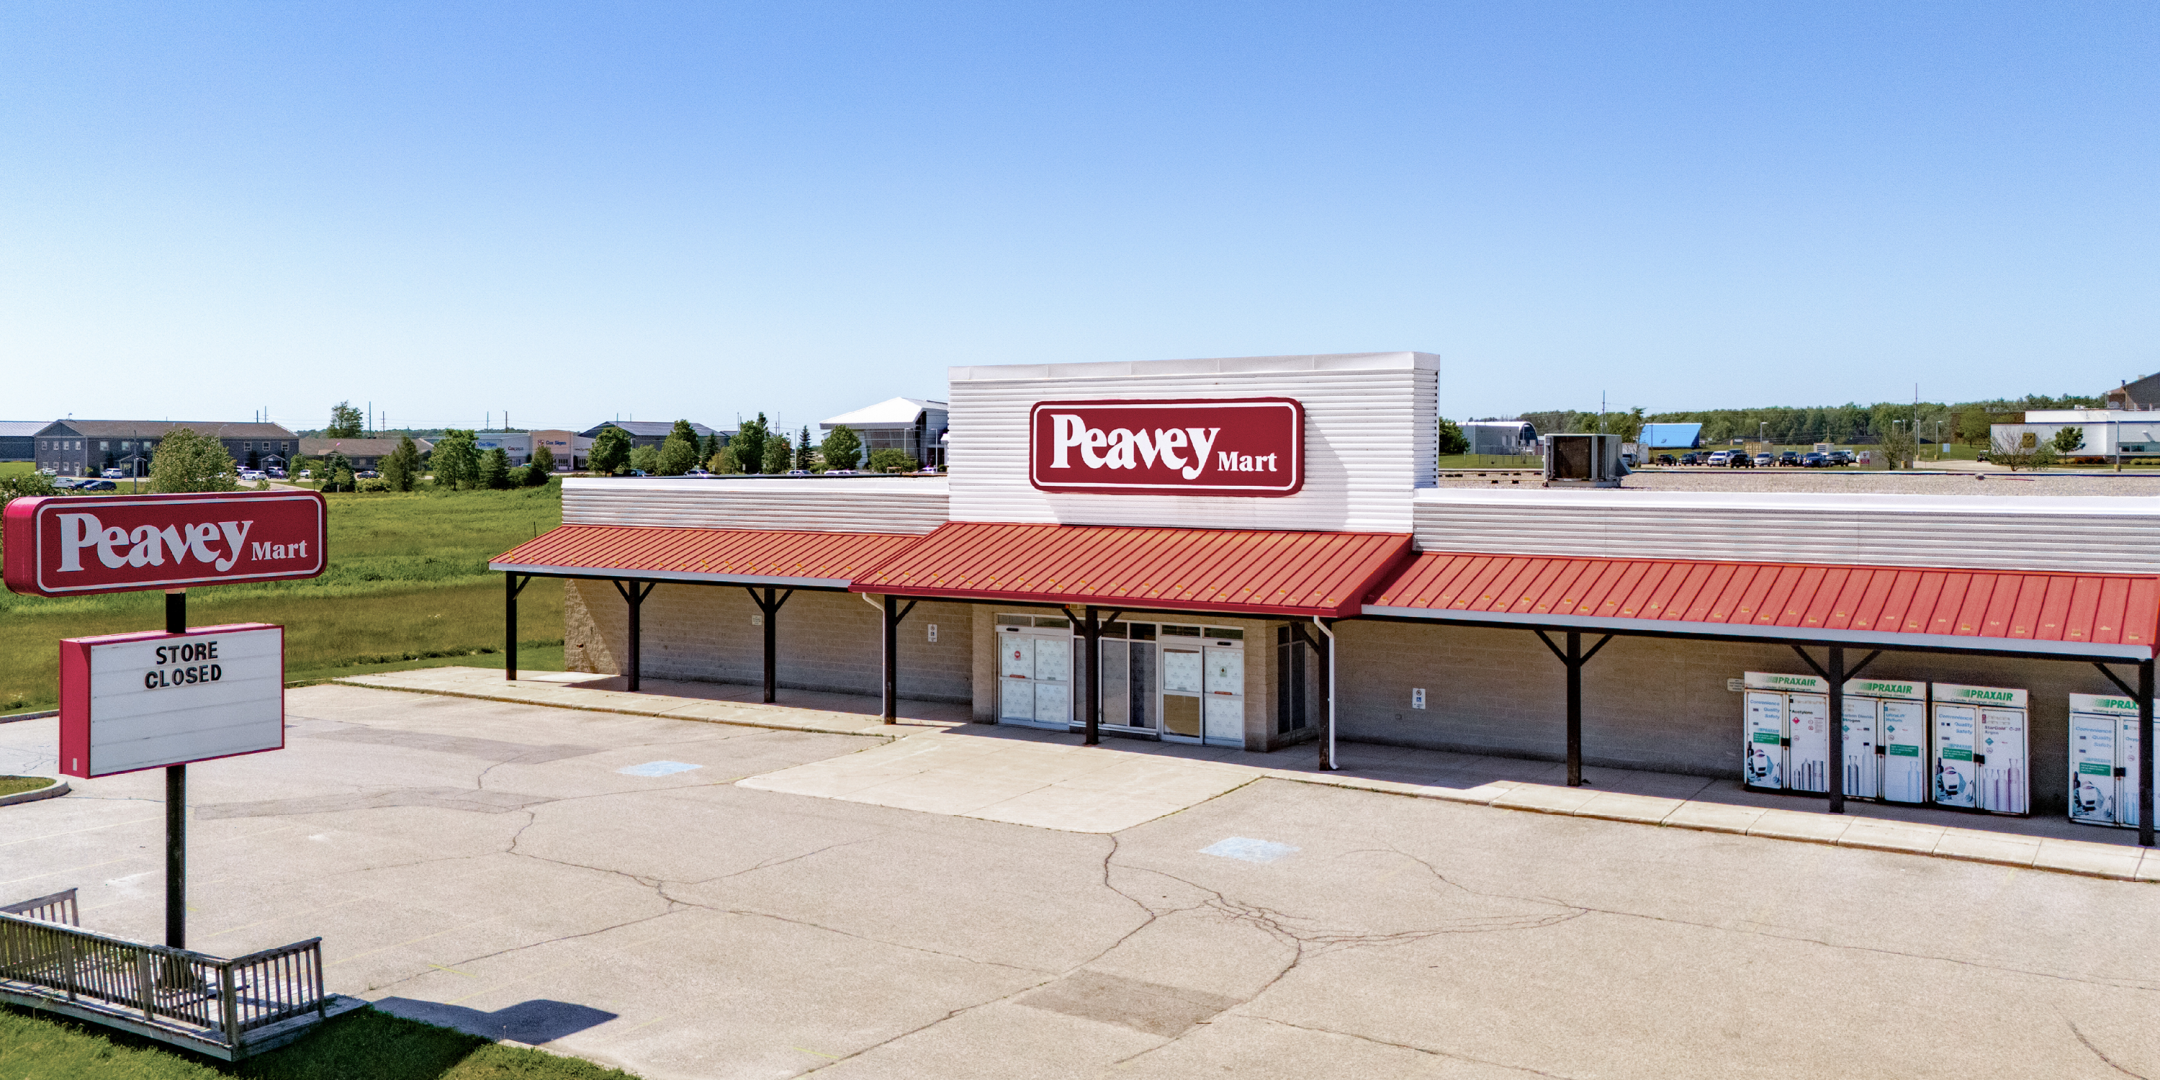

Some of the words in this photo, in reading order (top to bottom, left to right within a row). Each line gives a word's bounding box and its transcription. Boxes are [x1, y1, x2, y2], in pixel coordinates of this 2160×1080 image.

[1050, 414, 1221, 480] Peavey
[1217, 451, 1277, 472] Mart
[55, 513, 254, 573] Peavey
[251, 540, 308, 561] Mart
[155, 641, 218, 665] STORE
[145, 664, 222, 689] CLOSED
[1778, 676, 1816, 687] PRAXAIR
[1872, 683, 1913, 694] PRAXAIR
[1970, 689, 2013, 701] PRAXAIR
[2110, 699, 2139, 710] PRAX
[1939, 713, 1973, 721] Convenience
